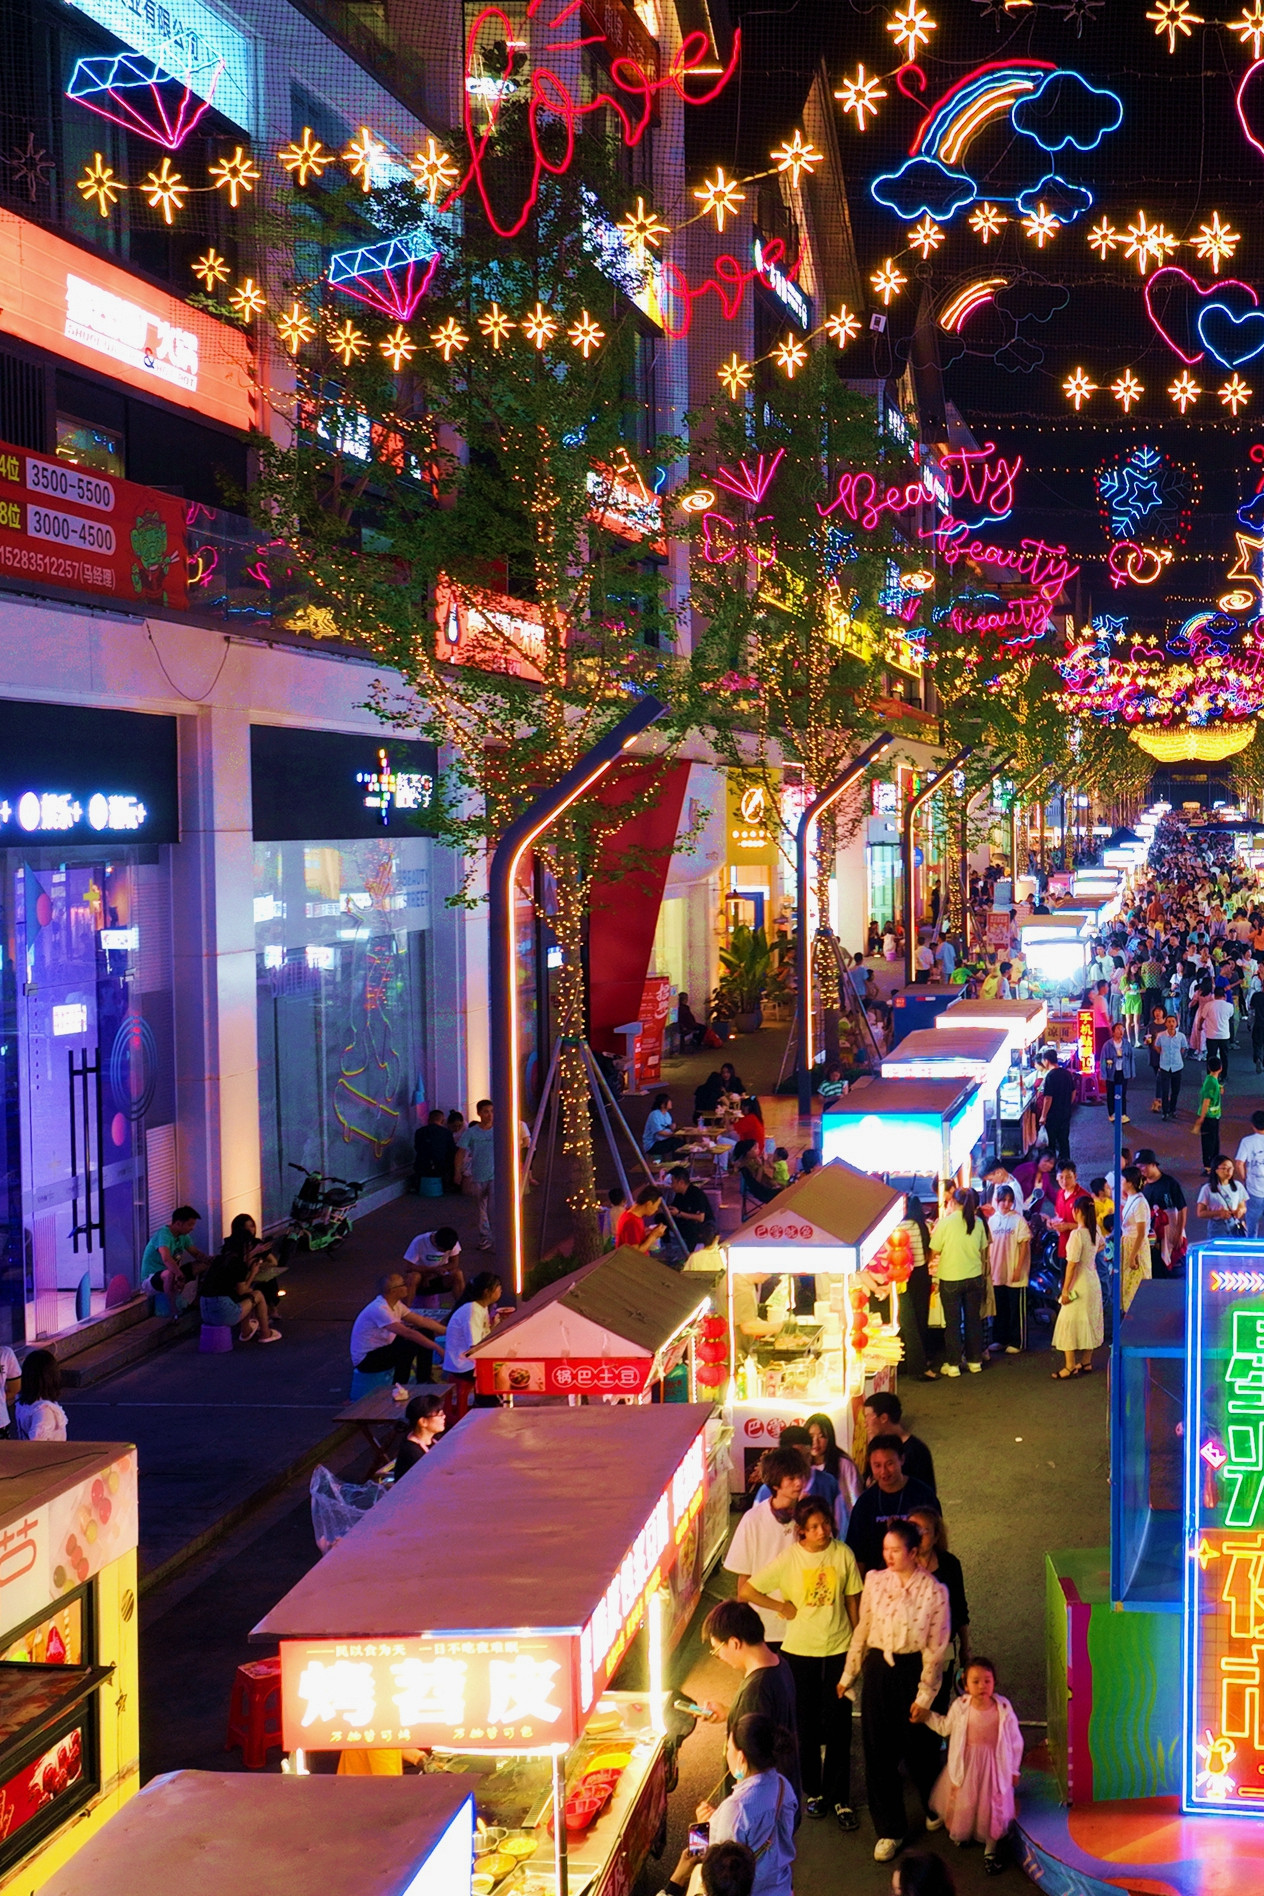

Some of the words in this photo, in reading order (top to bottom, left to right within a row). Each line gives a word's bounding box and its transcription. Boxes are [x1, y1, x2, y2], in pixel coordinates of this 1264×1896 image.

[32, 464, 111, 507] 3500-5500
[816, 441, 1022, 530] Beauty
[34, 511, 112, 551] 3000-4500
[554, 1367, 639, 1387] 锅巴土豆
[298, 1655, 562, 1726] 烤苕皮
